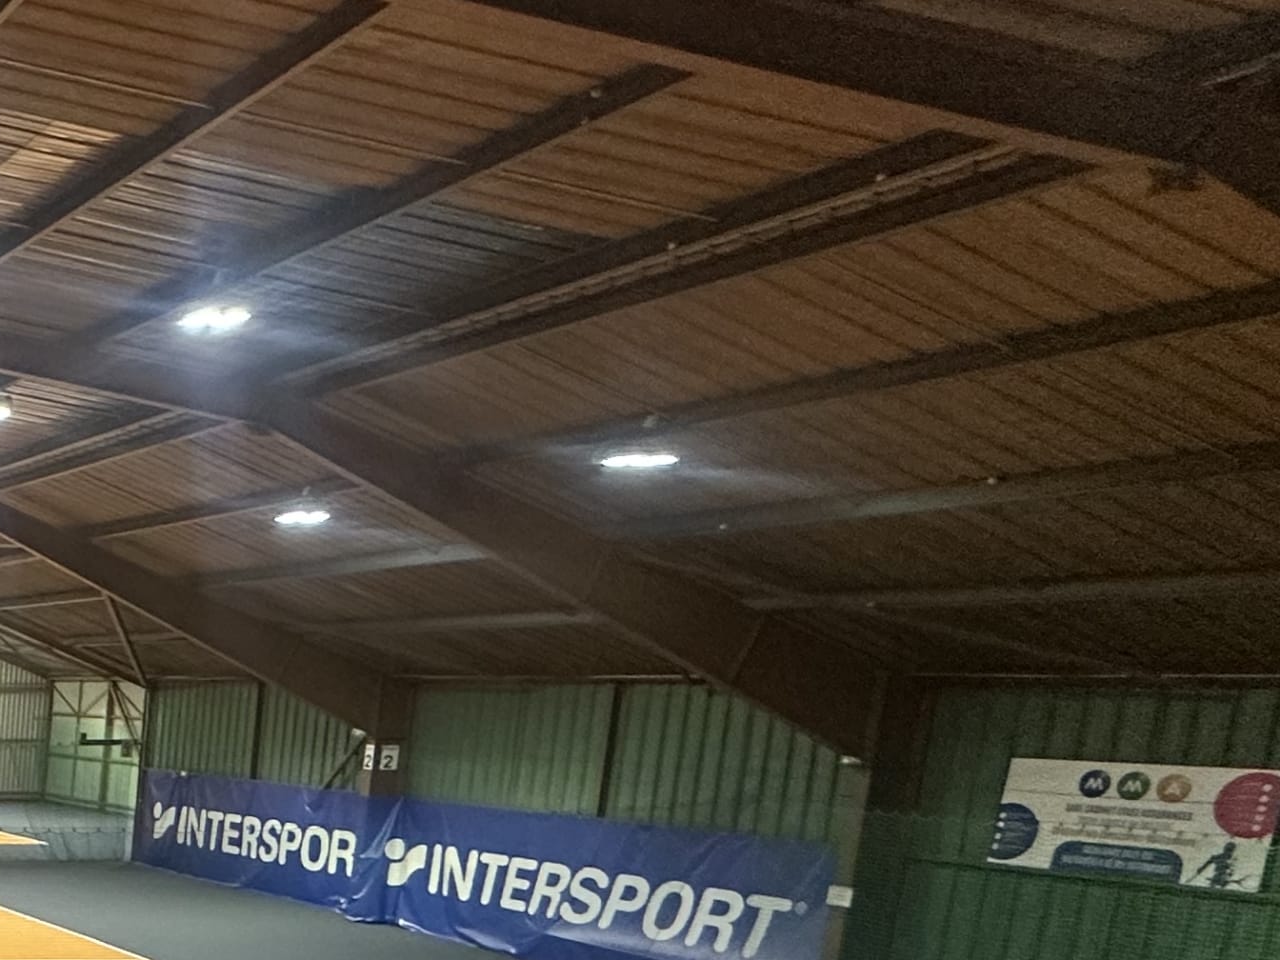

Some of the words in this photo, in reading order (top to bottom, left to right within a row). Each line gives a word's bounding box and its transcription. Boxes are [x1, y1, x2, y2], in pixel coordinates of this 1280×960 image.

[365, 754, 372, 768] 2
[383, 754, 393, 768] 2
[428, 844, 793, 960] INTERSPORT
